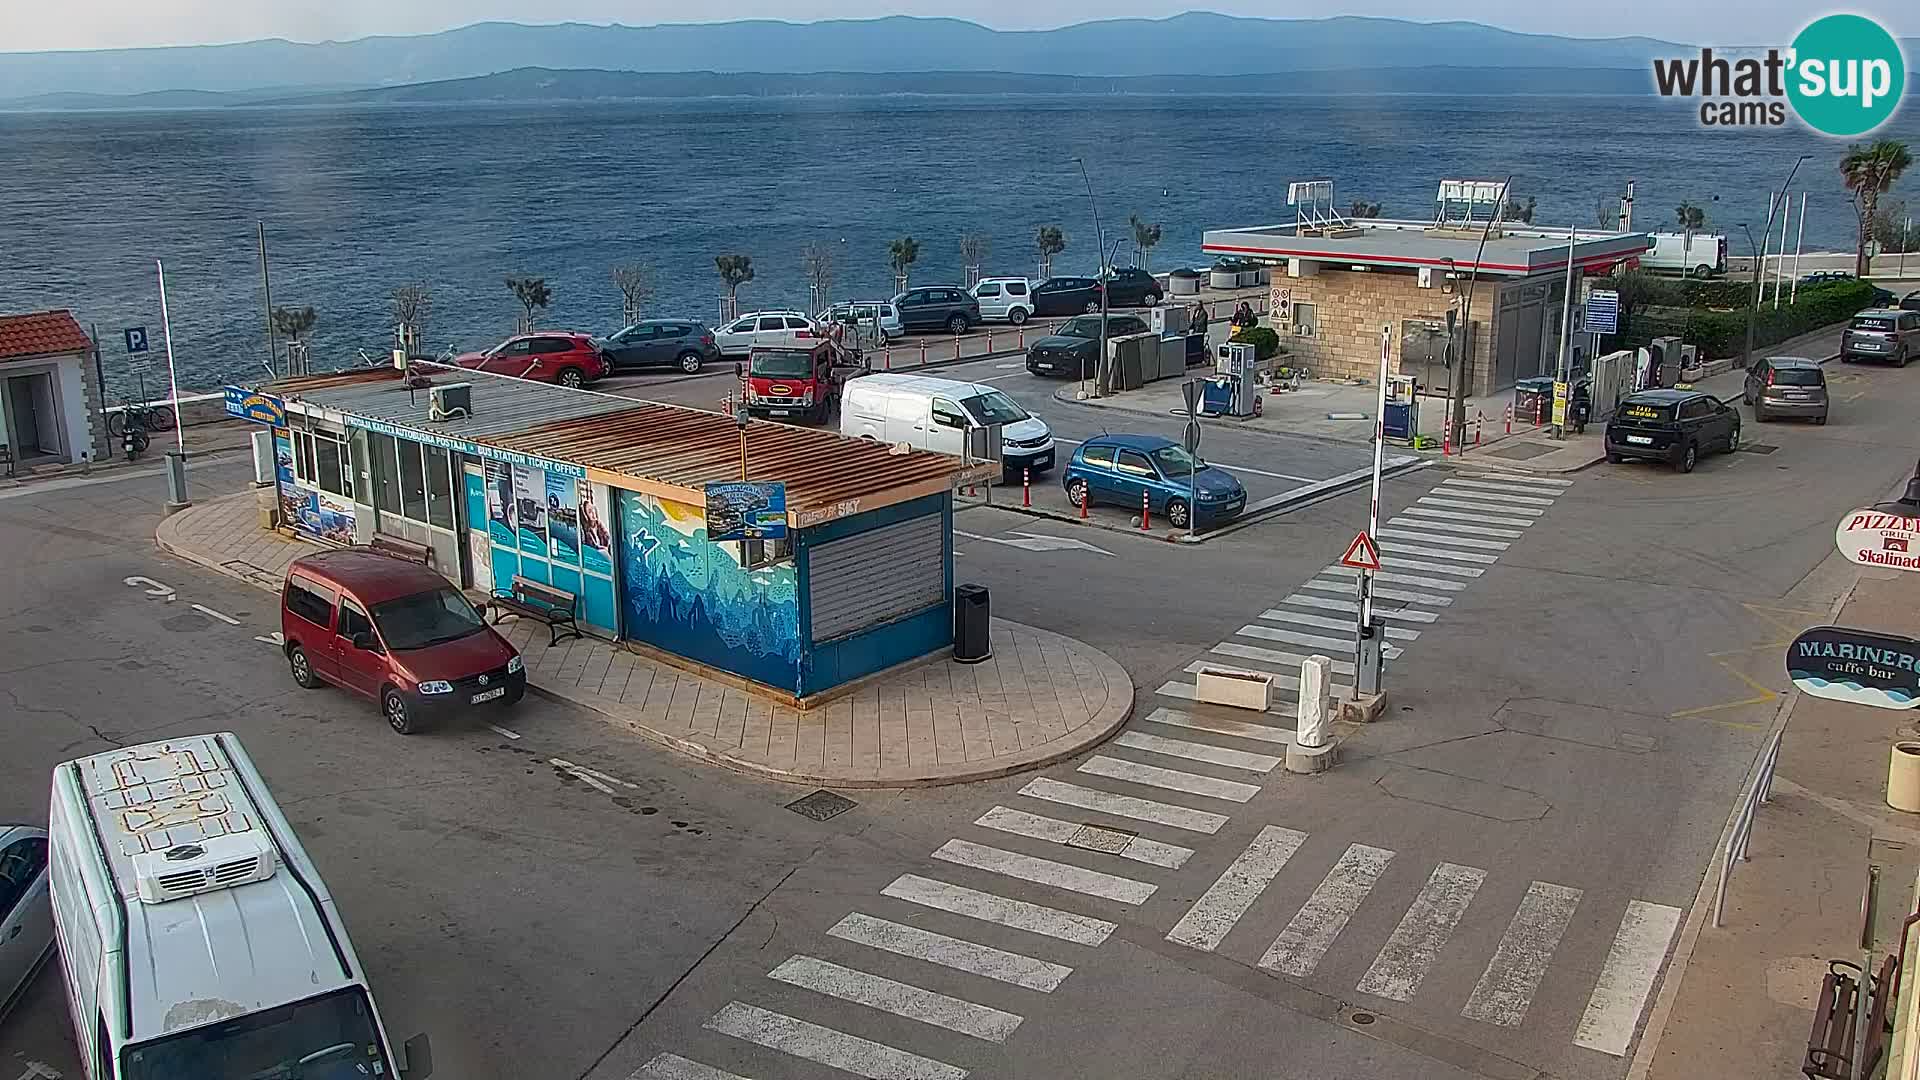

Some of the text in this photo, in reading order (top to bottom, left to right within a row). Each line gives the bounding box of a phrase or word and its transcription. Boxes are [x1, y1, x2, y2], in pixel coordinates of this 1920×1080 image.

[130, 331, 142, 349] P
[1636, 405, 1652, 413] TAXI
[395, 426, 435, 444] AUTOBUSNA
[436, 435, 467, 451] POSTAJA
[477, 447, 492, 457] BUS
[494, 449, 526, 464] STATION
[528, 456, 553, 471] TICKET
[554, 461, 582, 477] OFFICE
[1846, 515, 1920, 532] PIZZE
[1880, 530, 1915, 540] GRILL
[1858, 549, 1920, 568] Skalinad
[1827, 662, 1895, 680] caffe bar
